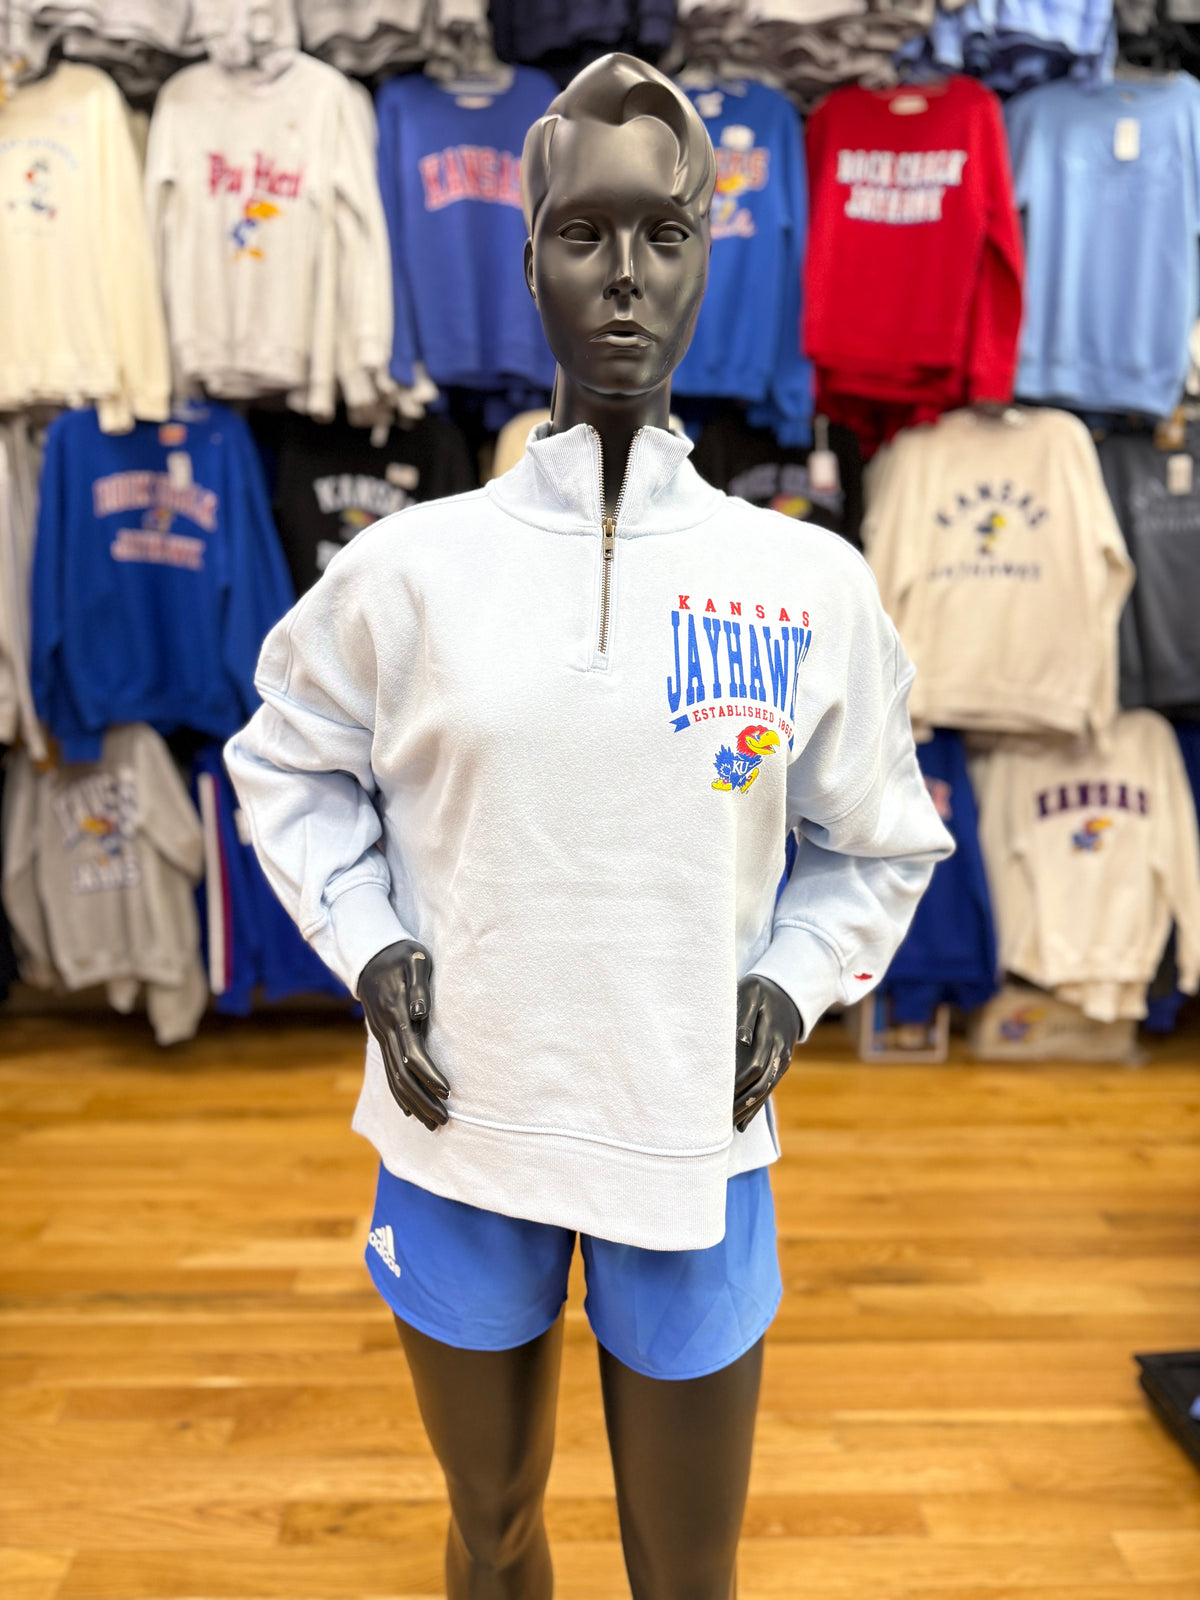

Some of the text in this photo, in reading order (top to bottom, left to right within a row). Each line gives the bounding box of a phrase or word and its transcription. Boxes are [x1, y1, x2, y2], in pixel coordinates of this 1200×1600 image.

[933, 480, 1049, 530] KANSAS
[678, 595, 810, 627] KANSAS
[692, 705, 775, 722] ESTABLISHED
[732, 760, 750, 776] KU
[1036, 780, 1149, 820] KANSAS
